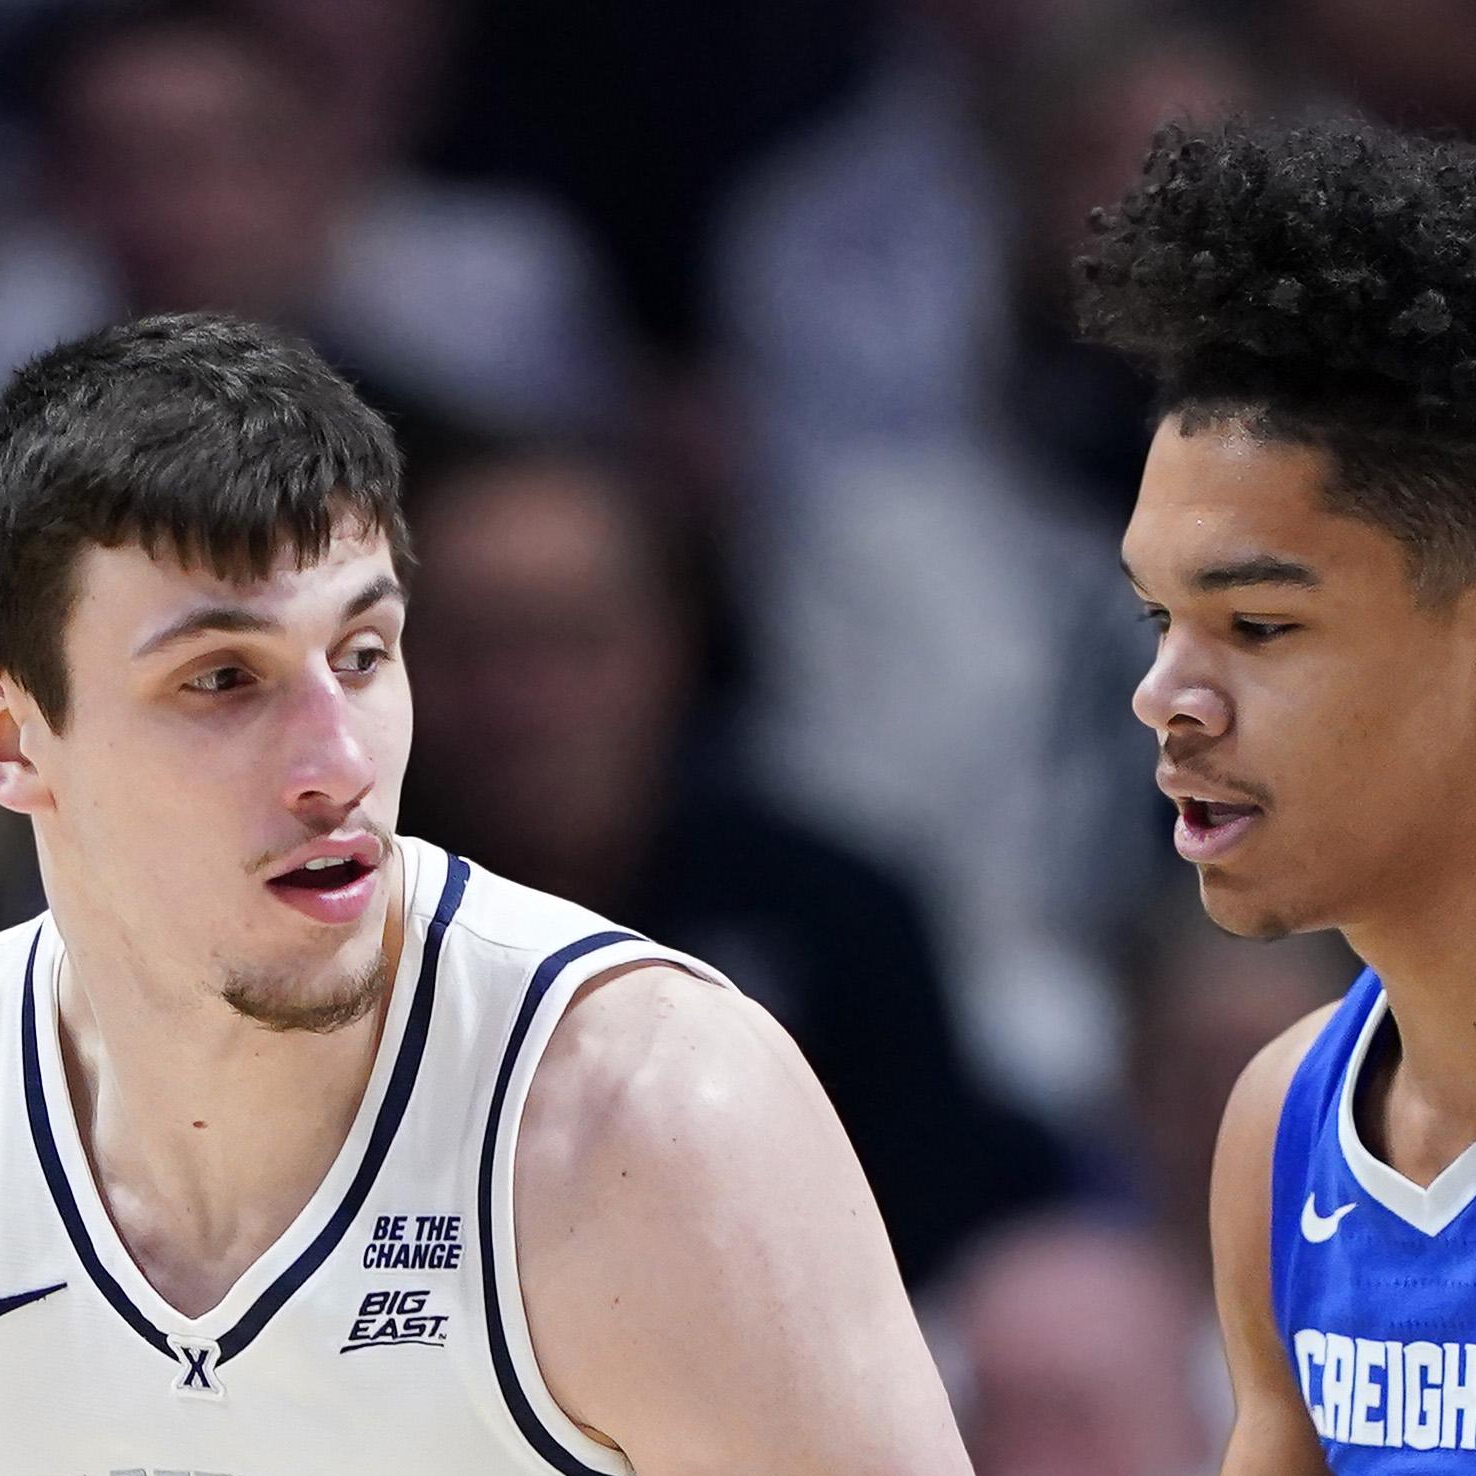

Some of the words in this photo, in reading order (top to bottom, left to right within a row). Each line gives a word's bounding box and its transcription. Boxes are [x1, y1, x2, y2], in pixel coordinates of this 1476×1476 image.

[372, 1215, 408, 1241] BE
[415, 1215, 461, 1242] THE
[362, 1243, 463, 1270] CHANGE
[358, 1290, 430, 1316] BIG
[348, 1315, 450, 1341] EAST
[179, 1344, 214, 1391] X
